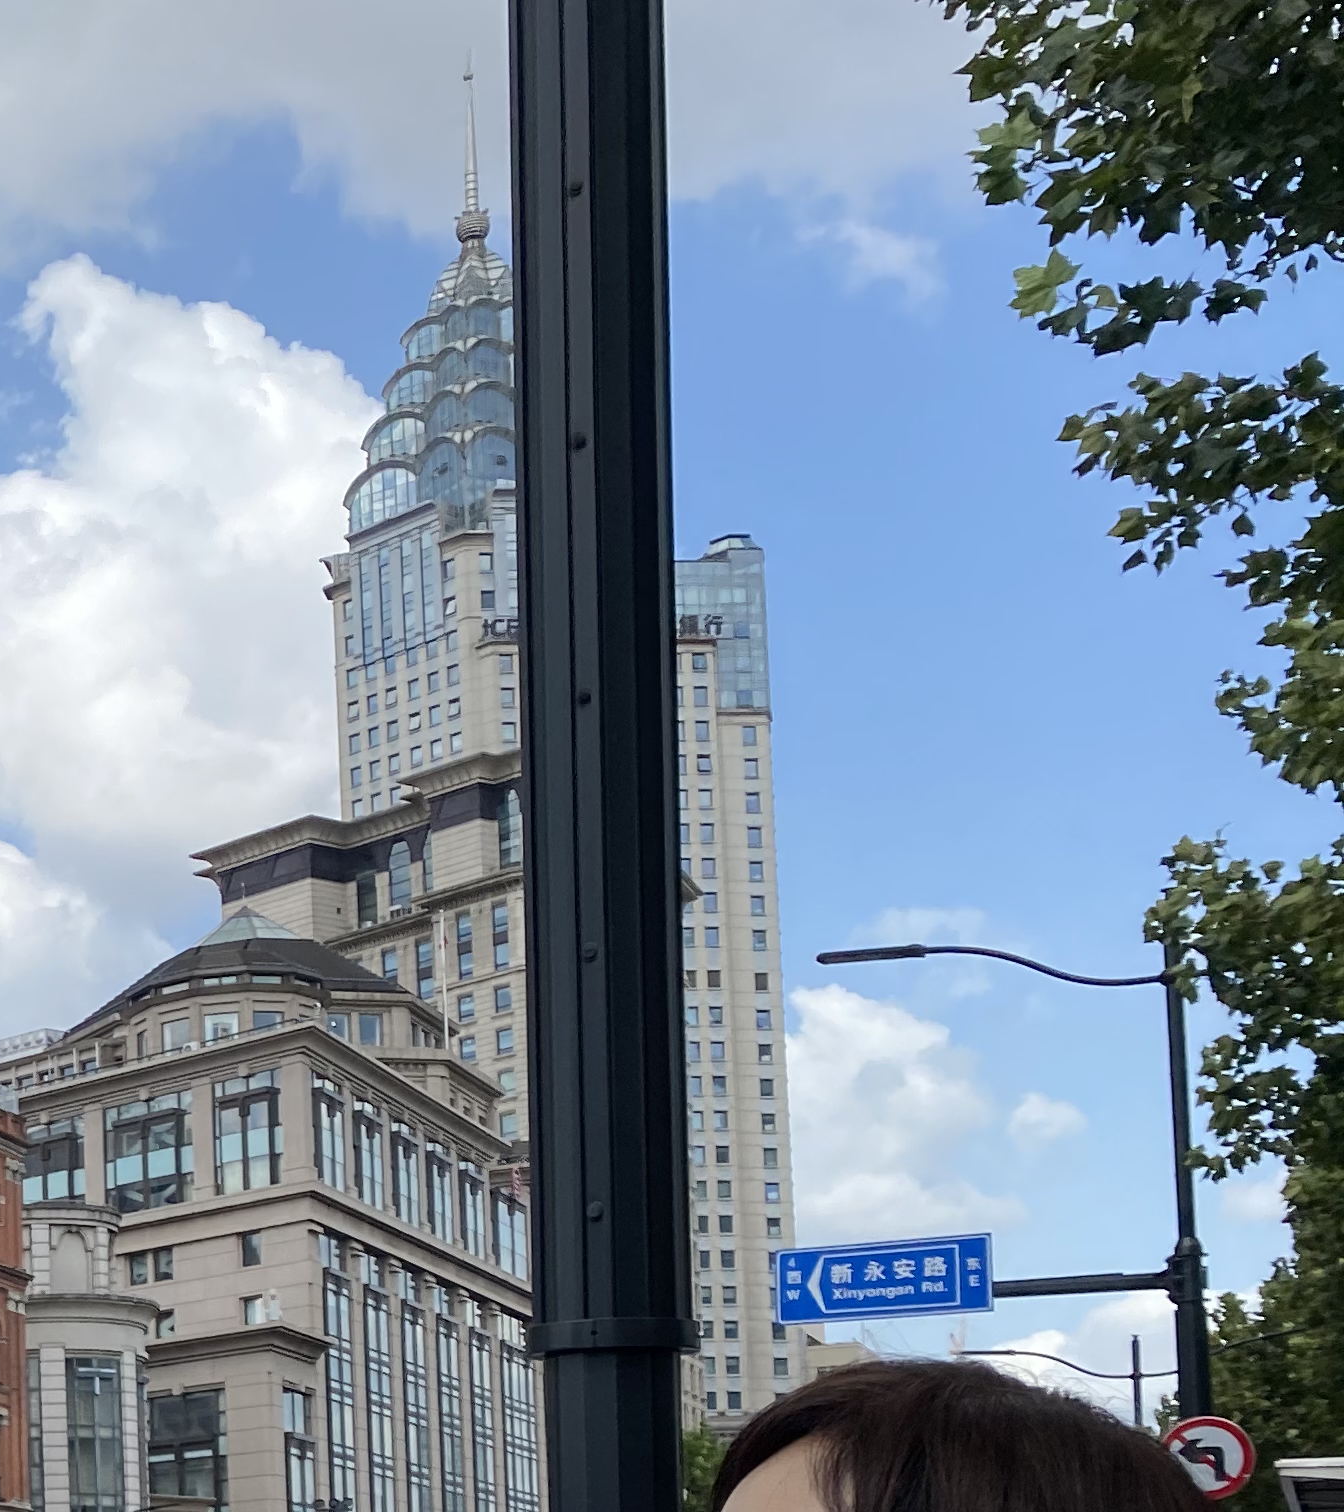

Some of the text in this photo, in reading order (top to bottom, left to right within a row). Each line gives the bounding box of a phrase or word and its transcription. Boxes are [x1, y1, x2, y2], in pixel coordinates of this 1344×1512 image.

[830, 1256, 948, 1285] 新永安路
[787, 1271, 802, 1285] 西
[968, 1275, 981, 1287] E
[787, 1290, 801, 1301] W
